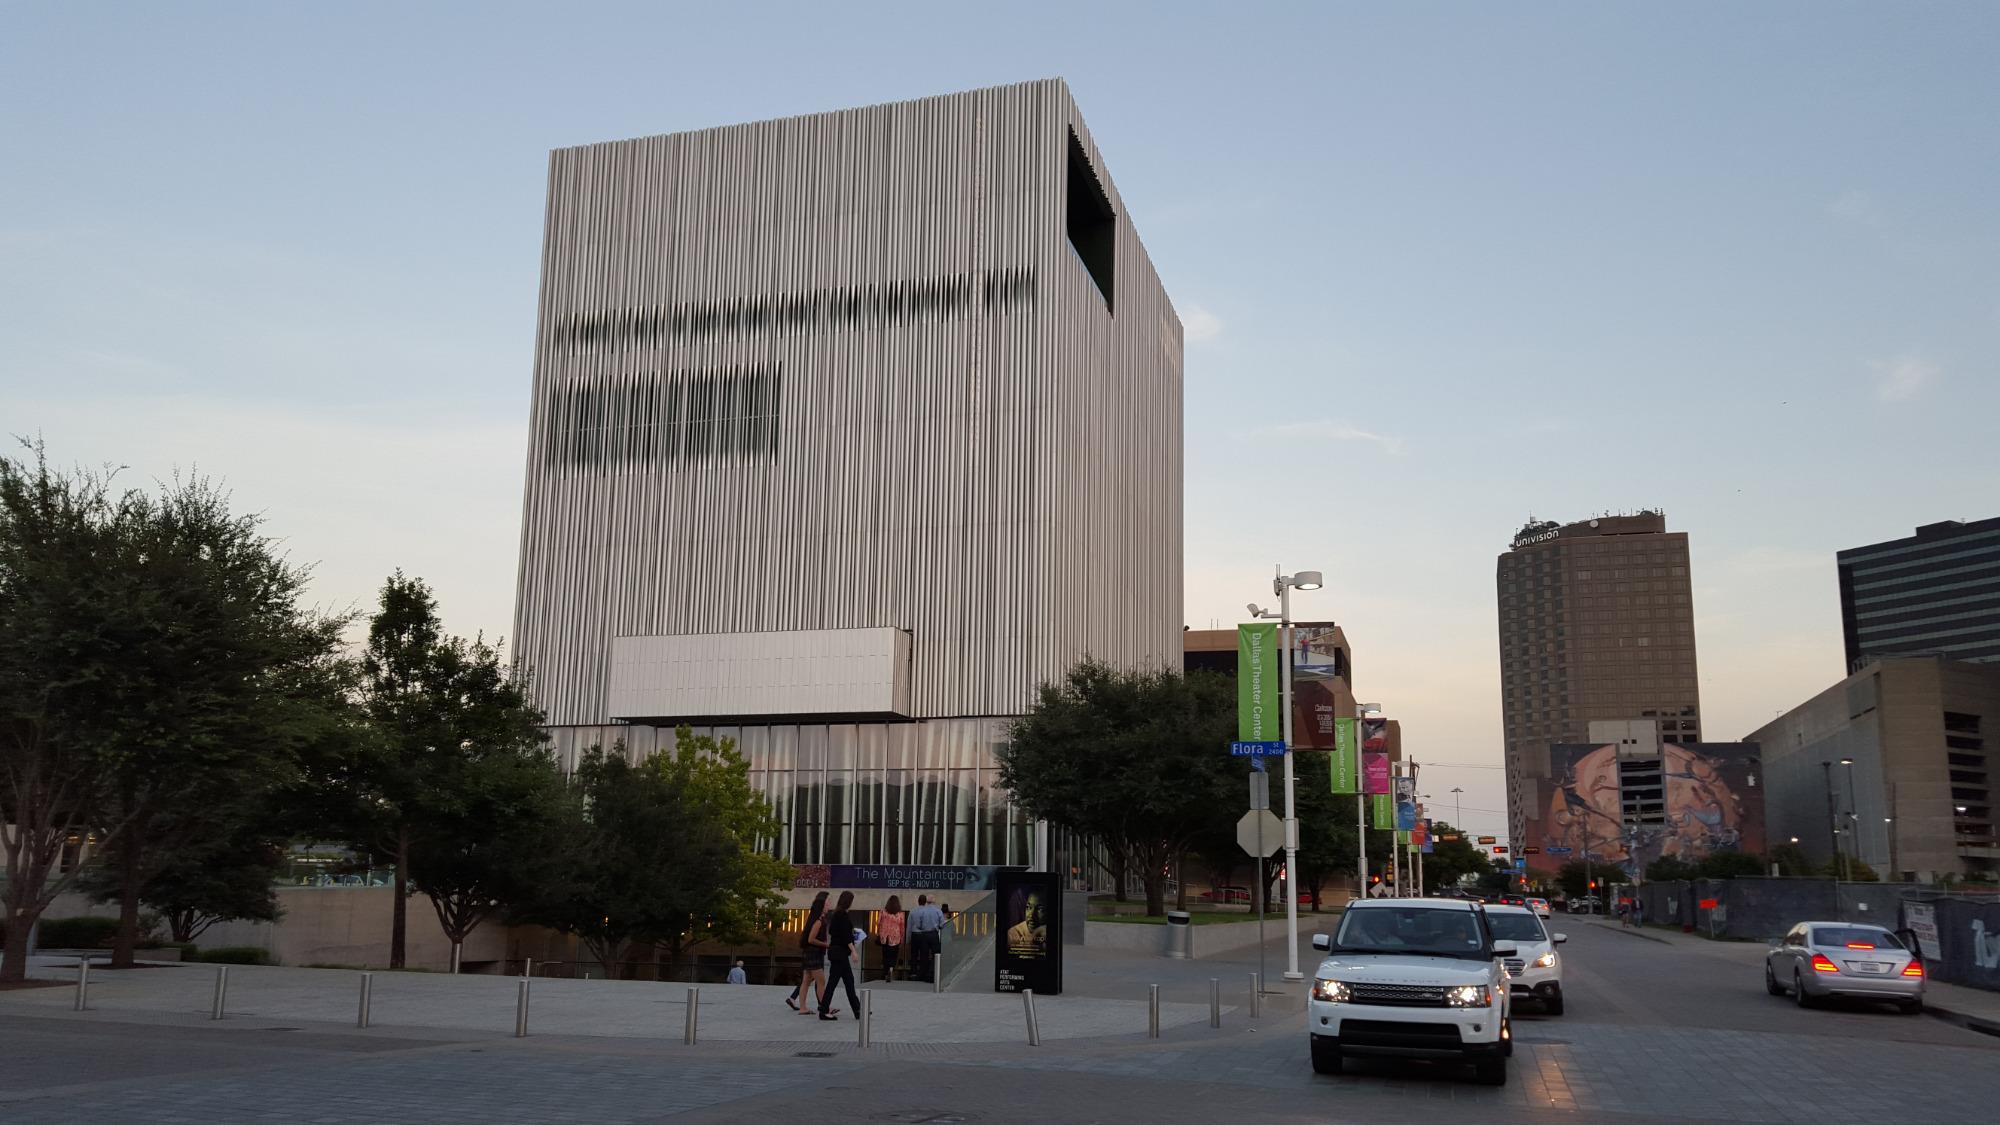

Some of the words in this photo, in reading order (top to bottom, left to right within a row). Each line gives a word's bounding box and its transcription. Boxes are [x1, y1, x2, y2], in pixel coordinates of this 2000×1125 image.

[1252, 632, 1262, 664] Dallas
[1252, 665, 1262, 704] Theater
[1252, 707, 1263, 741] Center
[1232, 743, 1264, 754] Flora
[856, 867, 879, 879] The
[884, 867, 964, 883] Mountaintop
[887, 880, 900, 888] SEP
[901, 880, 909, 888] 16
[916, 880, 930, 888] NOV
